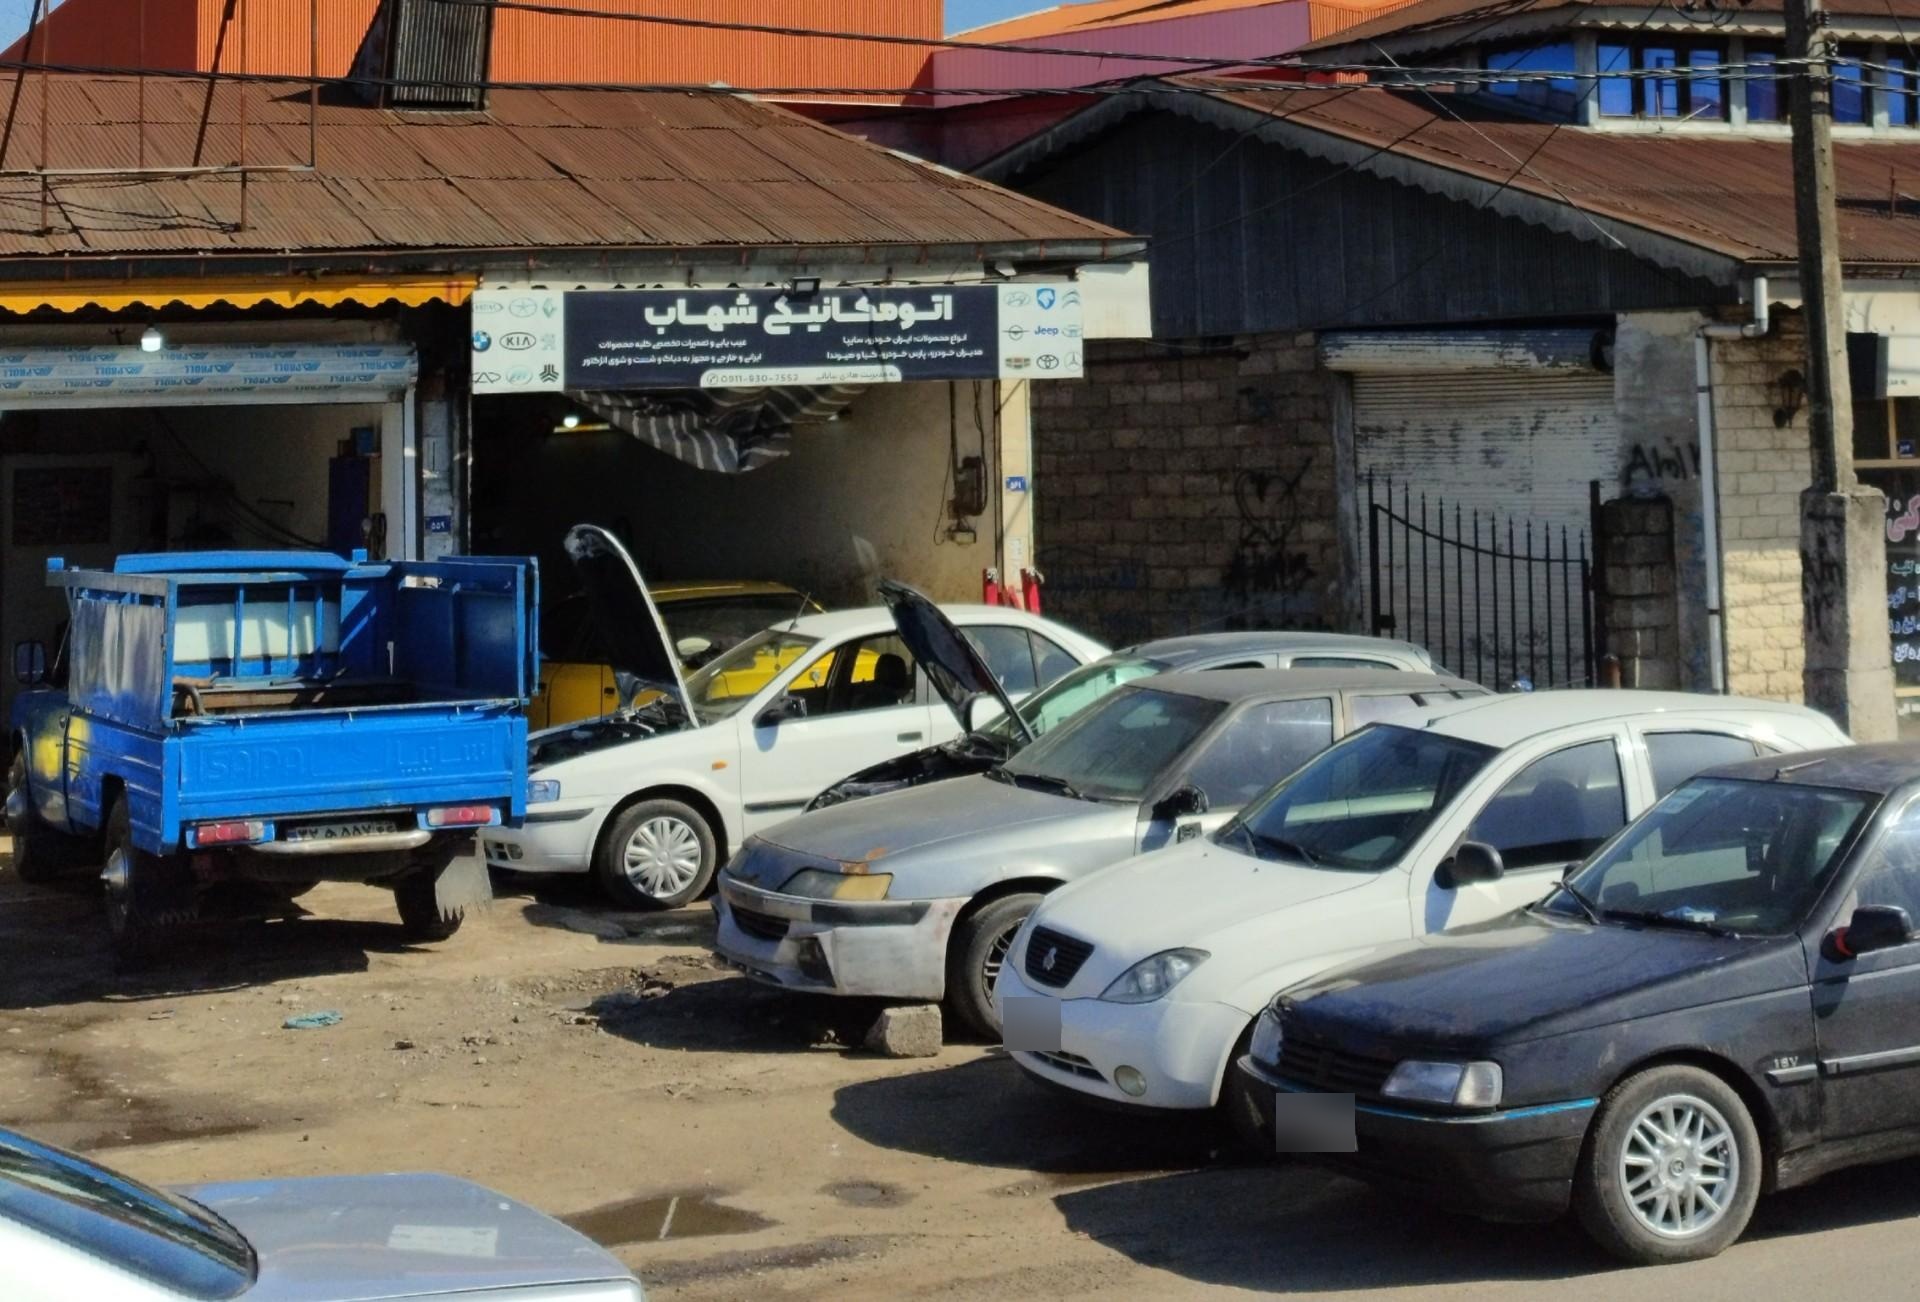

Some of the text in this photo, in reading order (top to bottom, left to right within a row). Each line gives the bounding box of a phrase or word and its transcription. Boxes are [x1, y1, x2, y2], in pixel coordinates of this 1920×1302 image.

[644, 293, 758, 335] شهاب
[1034, 325, 1059, 336] Jeep
[506, 336, 531, 346] KIA
[681, 339, 709, 349] تعمیرات
[730, 339, 747, 348] عیب
[842, 336, 864, 347] سایپا
[891, 334, 912, 345] ایران
[598, 341, 634, 351] محصولات
[635, 340, 652, 350] کلیه
[861, 351, 878, 360] کیا
[908, 349, 927, 360] پارس
[956, 348, 983, 358] مدیران
[691, 354, 710, 364] مجهز
[717, 354, 737, 364] خارجی
